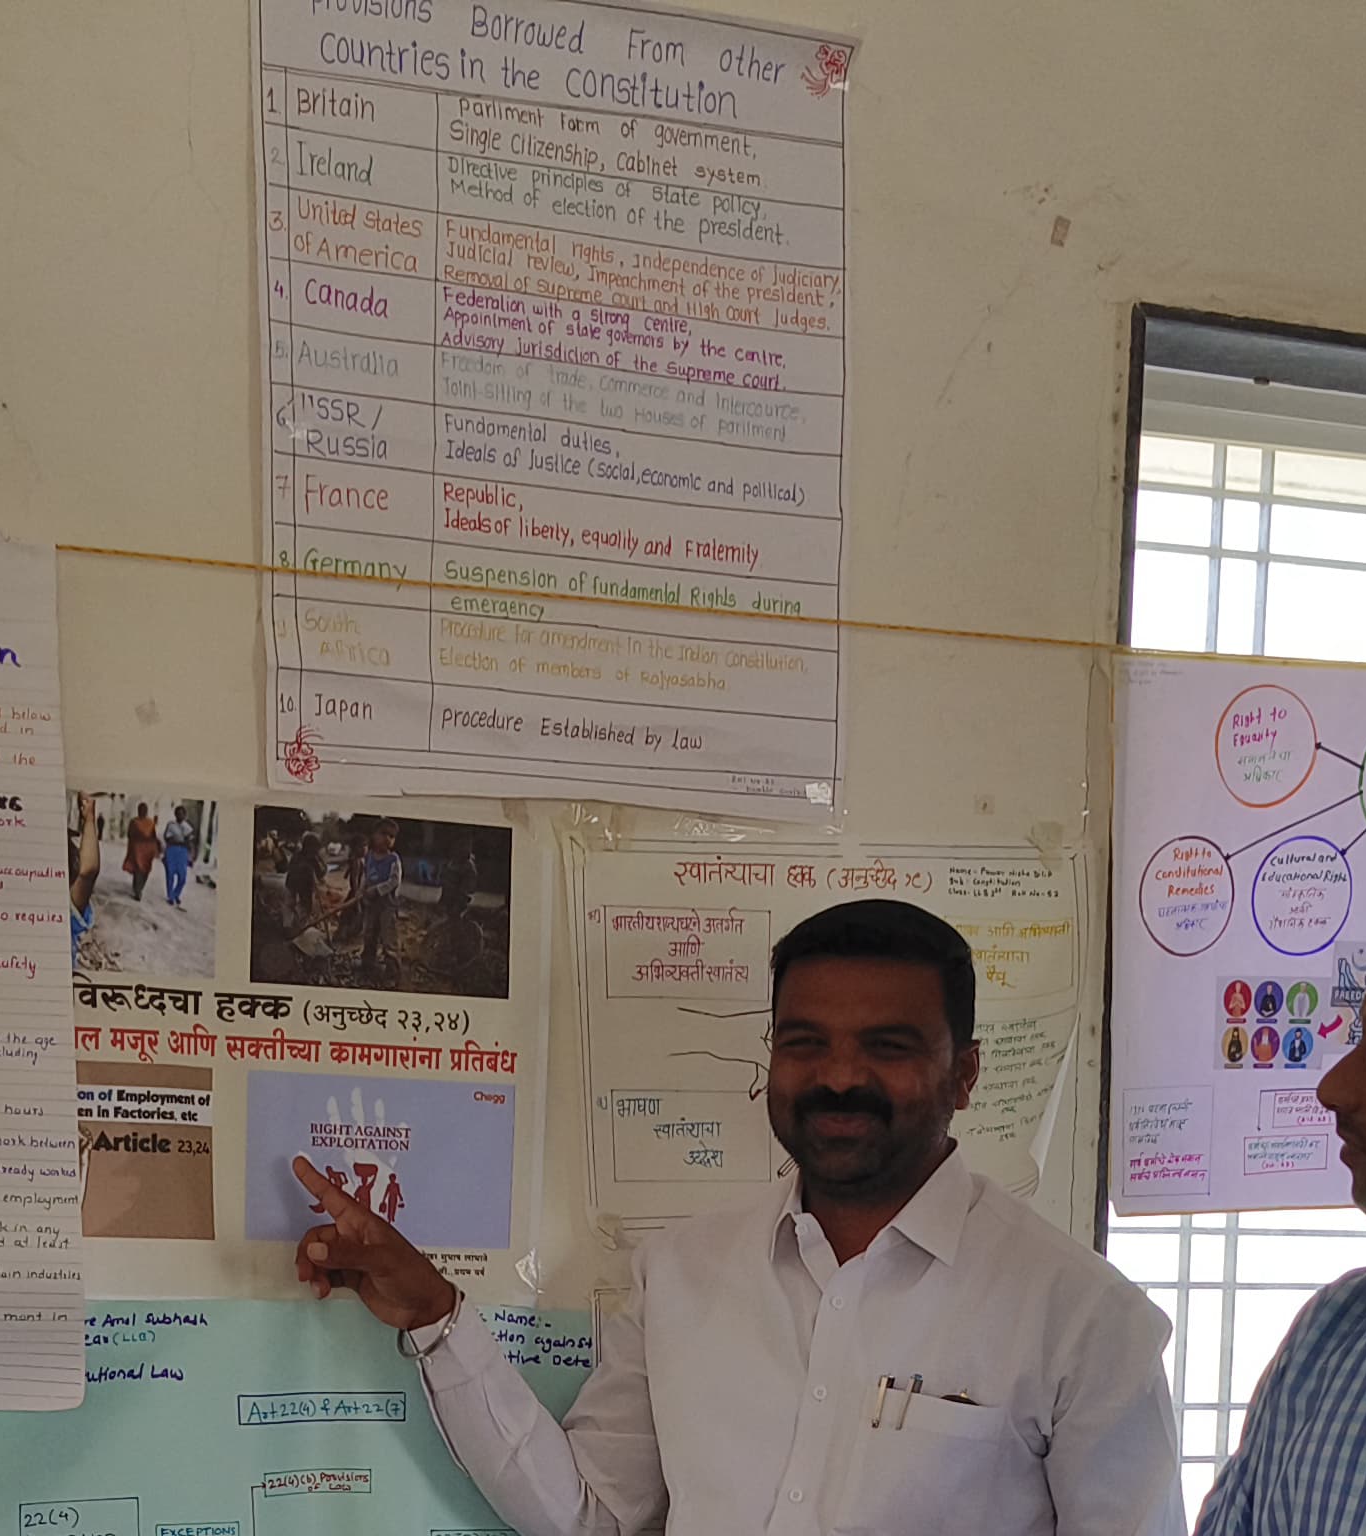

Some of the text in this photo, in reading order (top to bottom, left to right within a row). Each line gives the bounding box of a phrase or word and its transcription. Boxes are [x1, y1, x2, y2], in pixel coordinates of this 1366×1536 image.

[320, 32, 540, 90] Countries in the
[471, 4, 584, 55] Borrowed
[627, 27, 685, 67] From
[719, 45, 786, 85] other
[296, 87, 375, 122] Britain
[621, 119, 638, 139] of
[450, 119, 501, 154] Single
[296, 140, 373, 186] Ireland
[297, 196, 556, 252] United States Fundamental
[450, 178, 514, 203] Method
[551, 198, 617, 222] election
[626, 205, 645, 226] of
[654, 210, 685, 234] the
[294, 231, 419, 273] of America
[305, 278, 389, 319] Canada
[531, 301, 562, 320] with
[298, 340, 399, 377] Australia
[440, 329, 505, 358] Advisory
[305, 428, 735, 497] Russia Ideals and
[305, 473, 390, 516] France
[643, 536, 672, 560] and
[303, 547, 588, 592] Germany Suspension of
[450, 594, 545, 623] emergency
[314, 693, 703, 753] Japan Established by law
[215, 991, 293, 1022] हक्क
[110, 1028, 160, 1064] मजूर
[168, 1023, 217, 1058] आणि
[329, 1036, 443, 1071] कामगारांना
[450, 1040, 517, 1075] प्रतिबंध
[97, 1107, 111, 1118] in
[180, 1109, 198, 1122] etc
[99, 1089, 211, 1107] of Employment of
[473, 1091, 506, 1104] Chegg
[91, 1131, 210, 1155] Article 23,24
[310, 1123, 412, 1140] RIGHT AGAINST
[311, 1136, 411, 1152] EXPLOITATION
[24, 1507, 80, 1528] 22(4)
